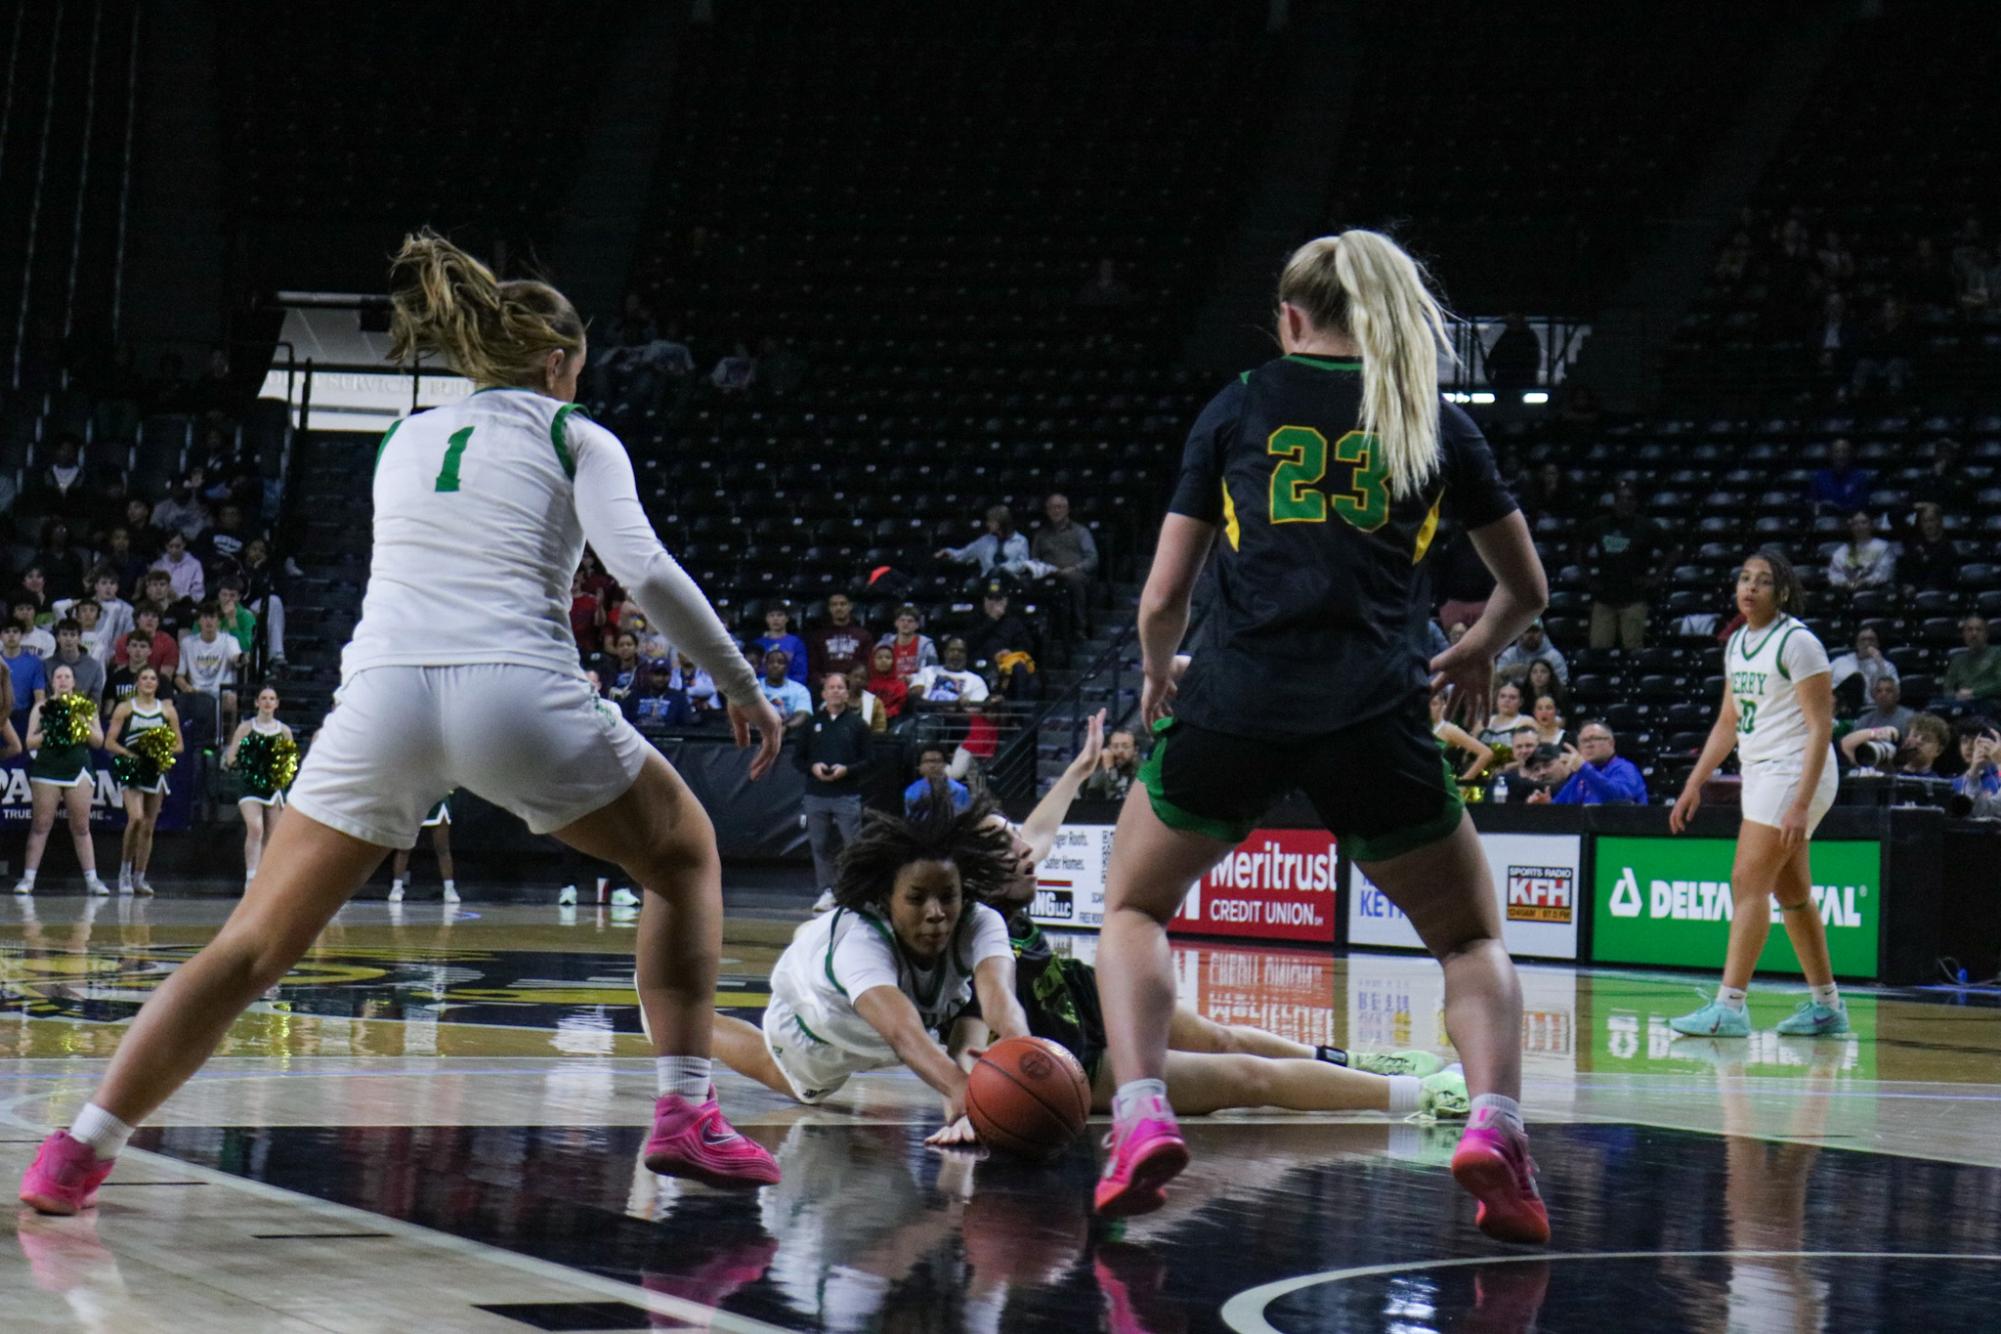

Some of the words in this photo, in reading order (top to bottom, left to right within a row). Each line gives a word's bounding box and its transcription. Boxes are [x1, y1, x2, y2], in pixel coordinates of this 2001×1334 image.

[435, 425, 475, 493] 1
[1267, 425, 1392, 534] 23
[1731, 671, 1768, 695] ERBY
[2, 808, 33, 820] TRUE
[1209, 840, 1339, 892] Meritrust
[1509, 867, 1543, 877] SPORTS
[1544, 868, 1572, 879] RADIO
[1029, 891, 1056, 917] ING
[1509, 877, 1570, 907] KFH
[1650, 880, 1734, 921] DELTA
[1768, 885, 1861, 928] ETAL
[1210, 898, 1263, 923] CREDIT
[1264, 900, 1316, 927] UNION
